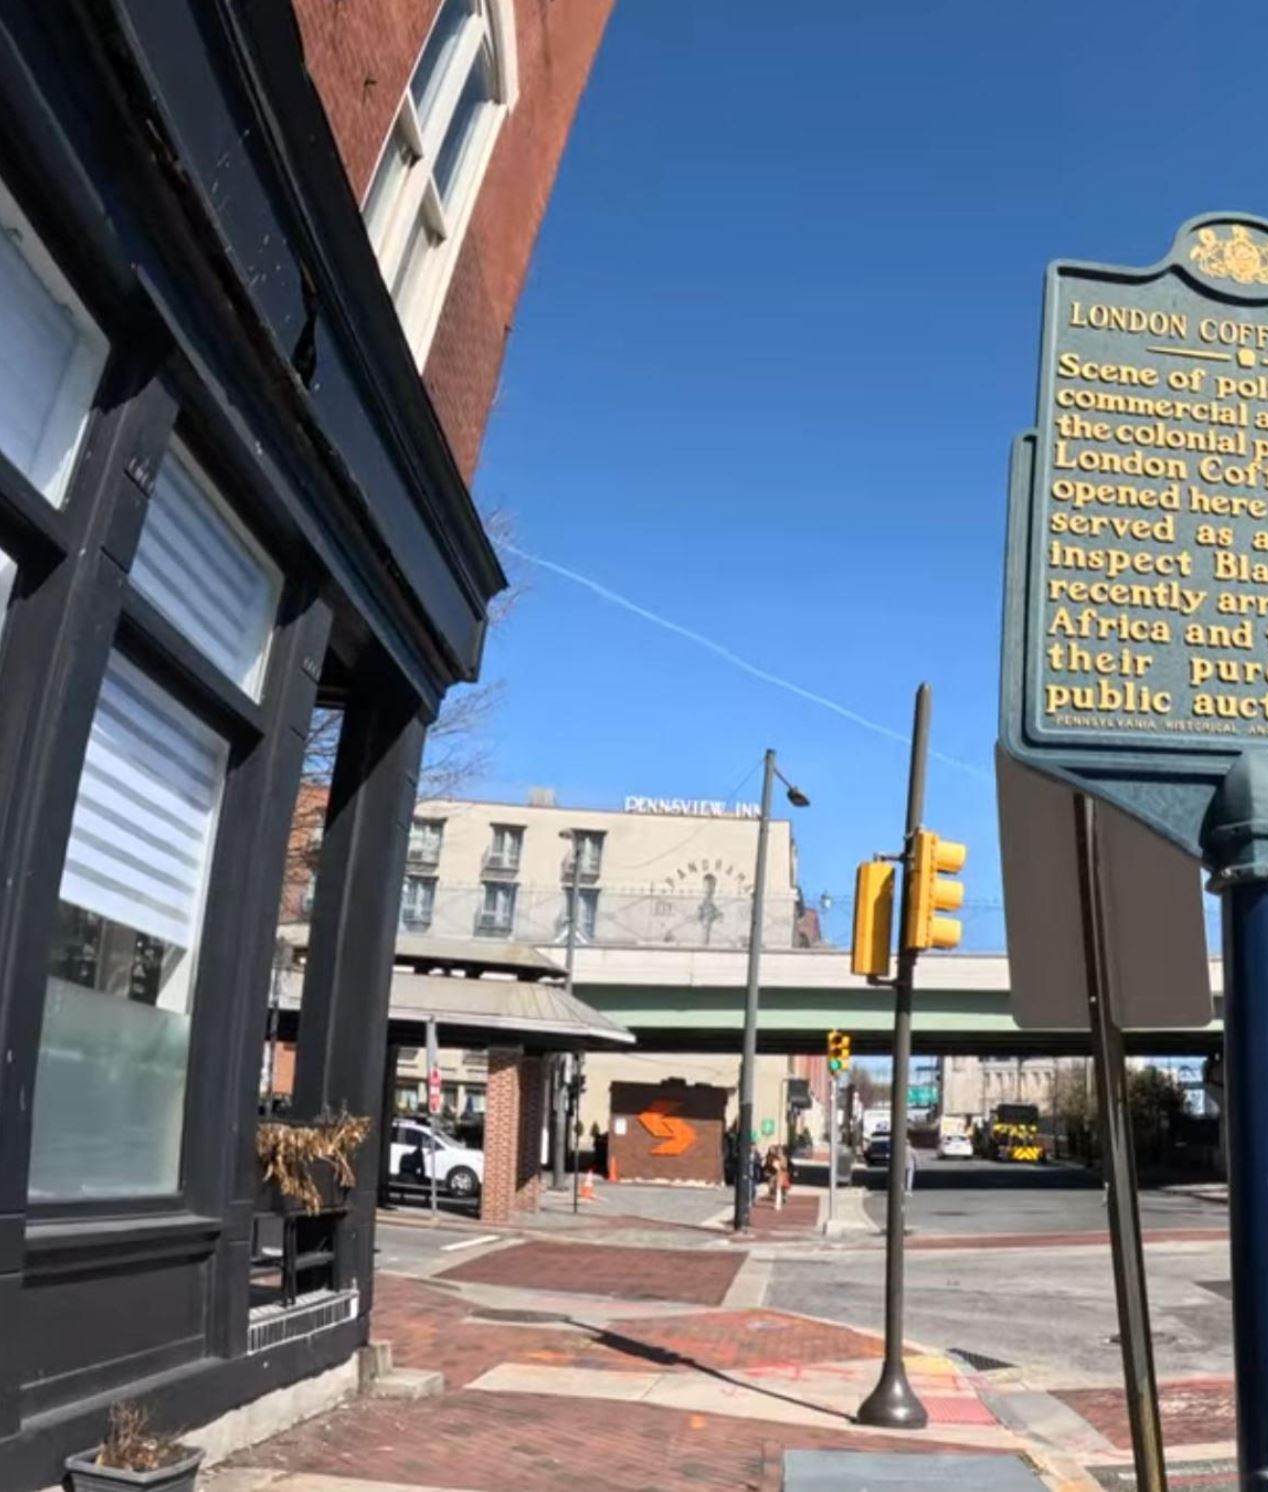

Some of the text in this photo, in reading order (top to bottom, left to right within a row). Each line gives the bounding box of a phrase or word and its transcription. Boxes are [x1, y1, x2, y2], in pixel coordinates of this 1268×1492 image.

[1071, 302, 1187, 339] LONDON
[1058, 352, 1158, 386] Scene
[1168, 368, 1205, 392] of
[1057, 388, 1248, 437] commercial
[1056, 415, 1110, 441] the
[1116, 423, 1245, 455] colonial
[1054, 442, 1187, 481] London
[1051, 476, 1180, 512] opened
[1189, 487, 1268, 518] here
[1050, 510, 1175, 543] served
[1196, 525, 1232, 549] as
[1049, 541, 1192, 578] inspect
[1048, 576, 1207, 615] recently
[1048, 607, 1170, 643] Africa
[1184, 621, 1253, 650] and
[1047, 642, 1152, 676] their
[1046, 683, 1171, 715] public
[1056, 714, 1158, 730] PENNSYLVANIA
[1165, 719, 1238, 734] HISTORICAL
